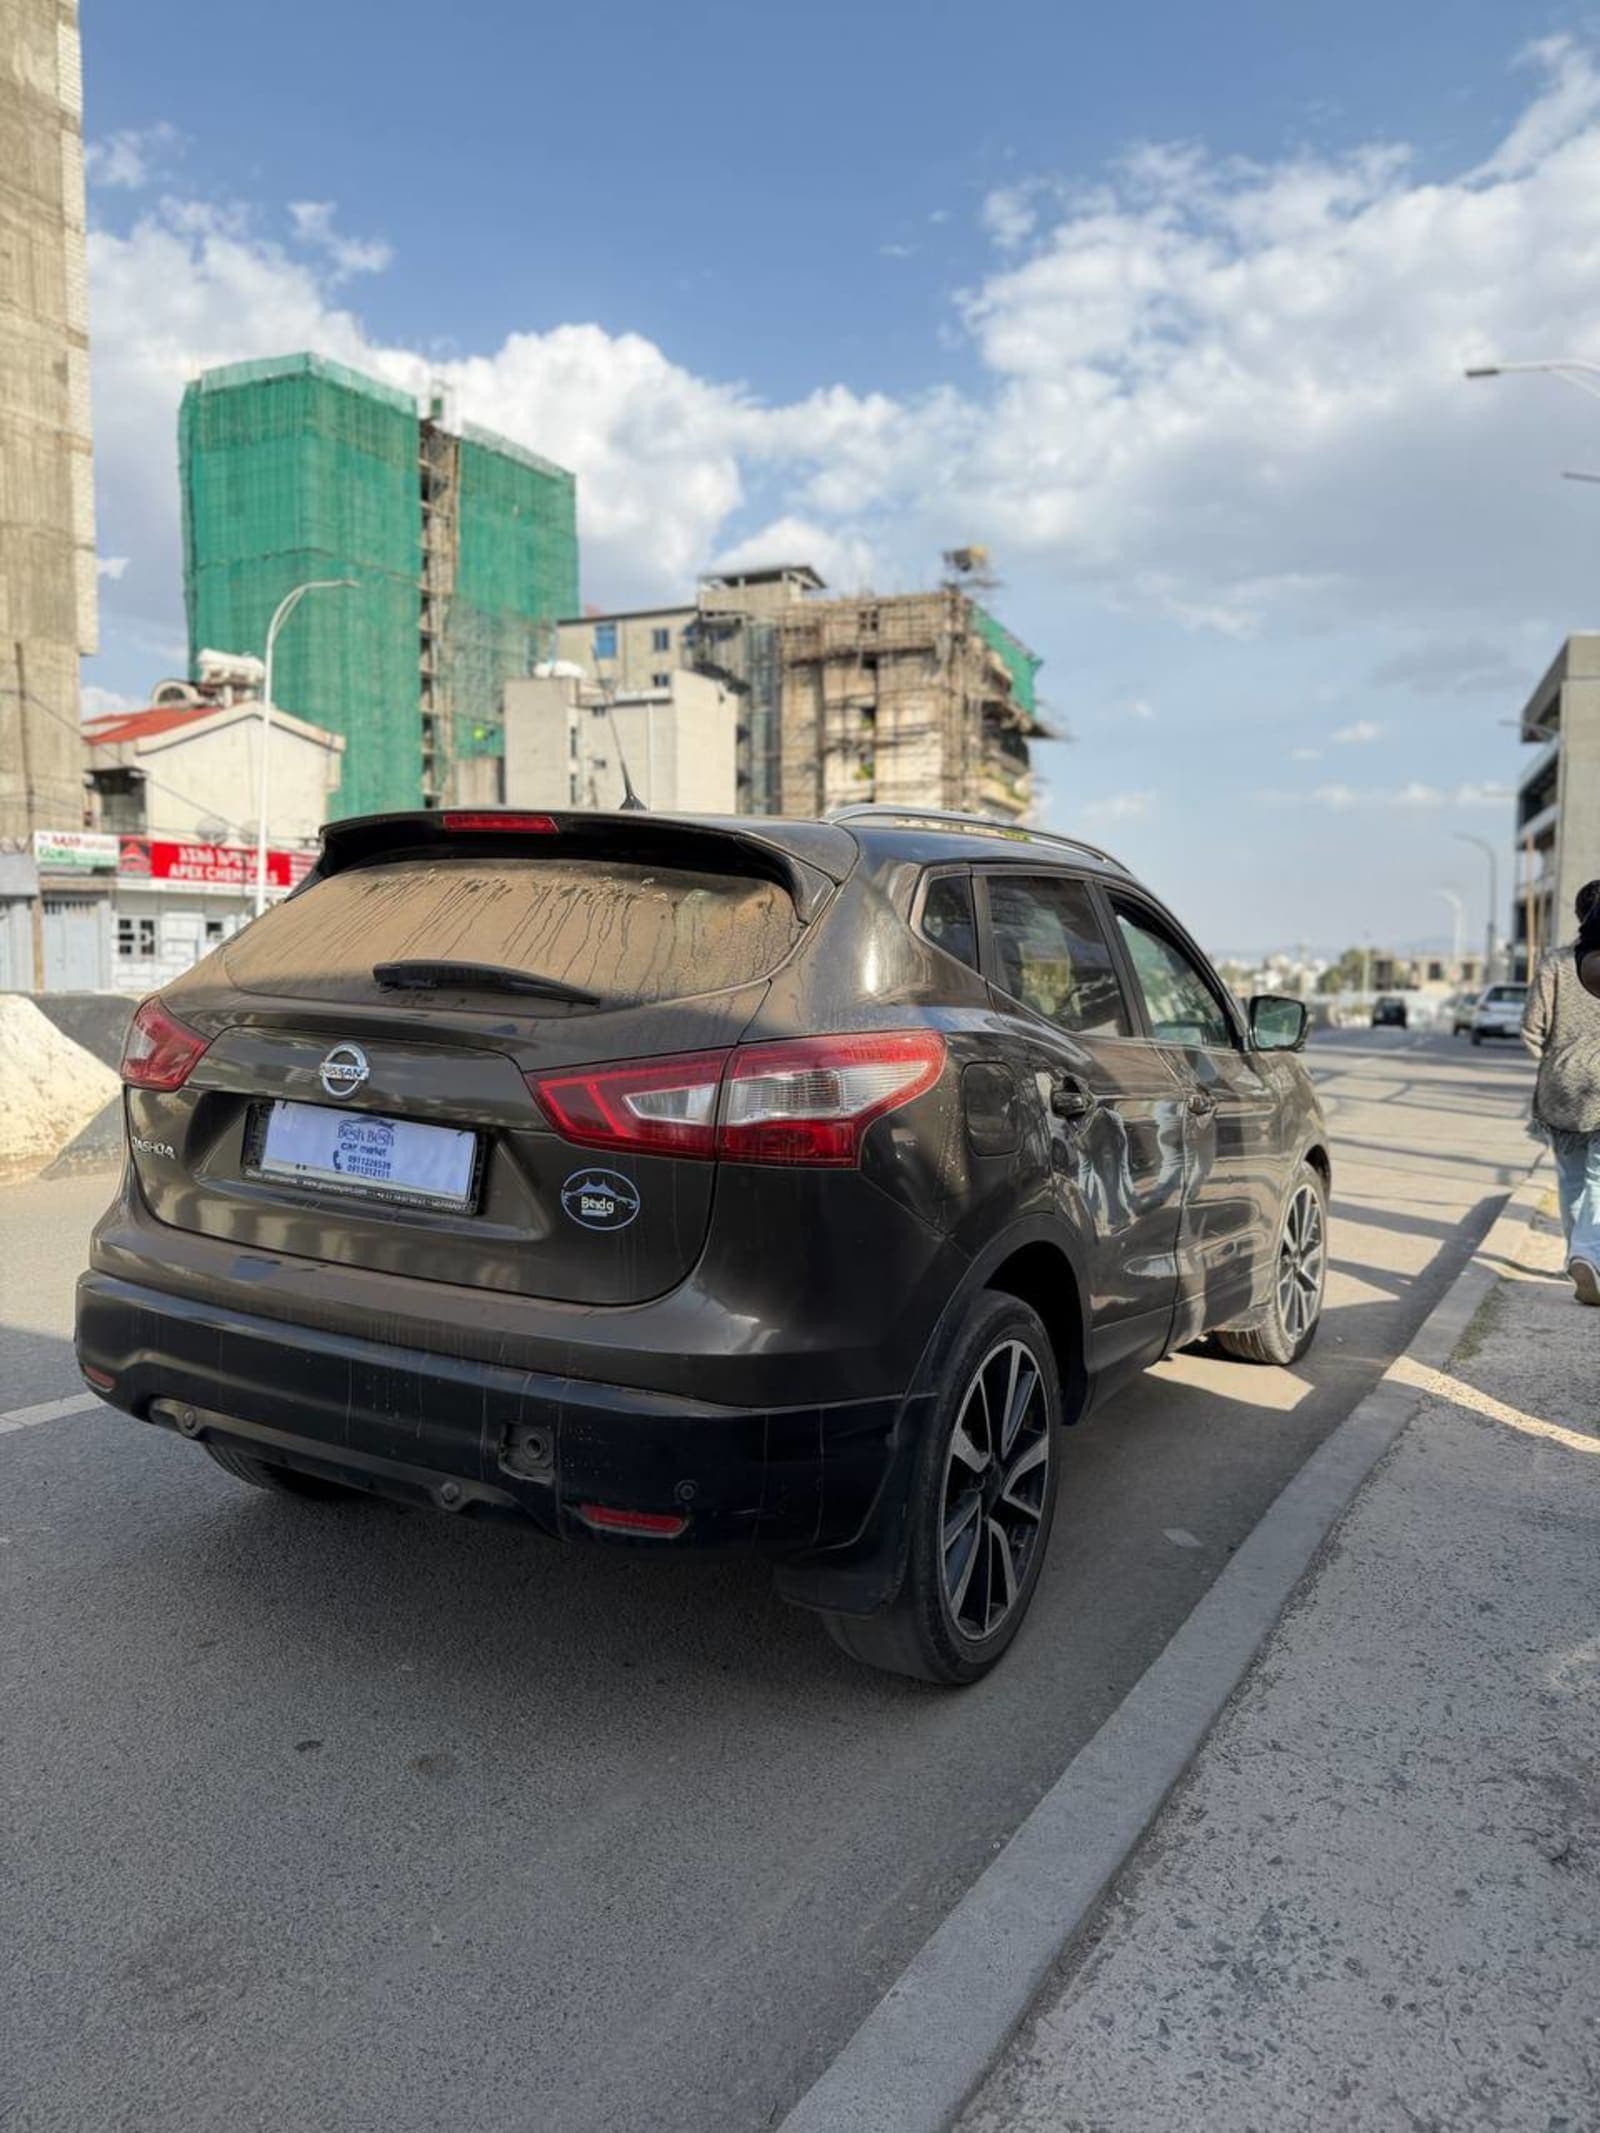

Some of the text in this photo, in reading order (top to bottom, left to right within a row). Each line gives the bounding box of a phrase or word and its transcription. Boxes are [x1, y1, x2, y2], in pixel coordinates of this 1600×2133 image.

[167, 863, 204, 881] APEX
[205, 866, 279, 885] CHEMCLS
[321, 1063, 368, 1080] NISSAN
